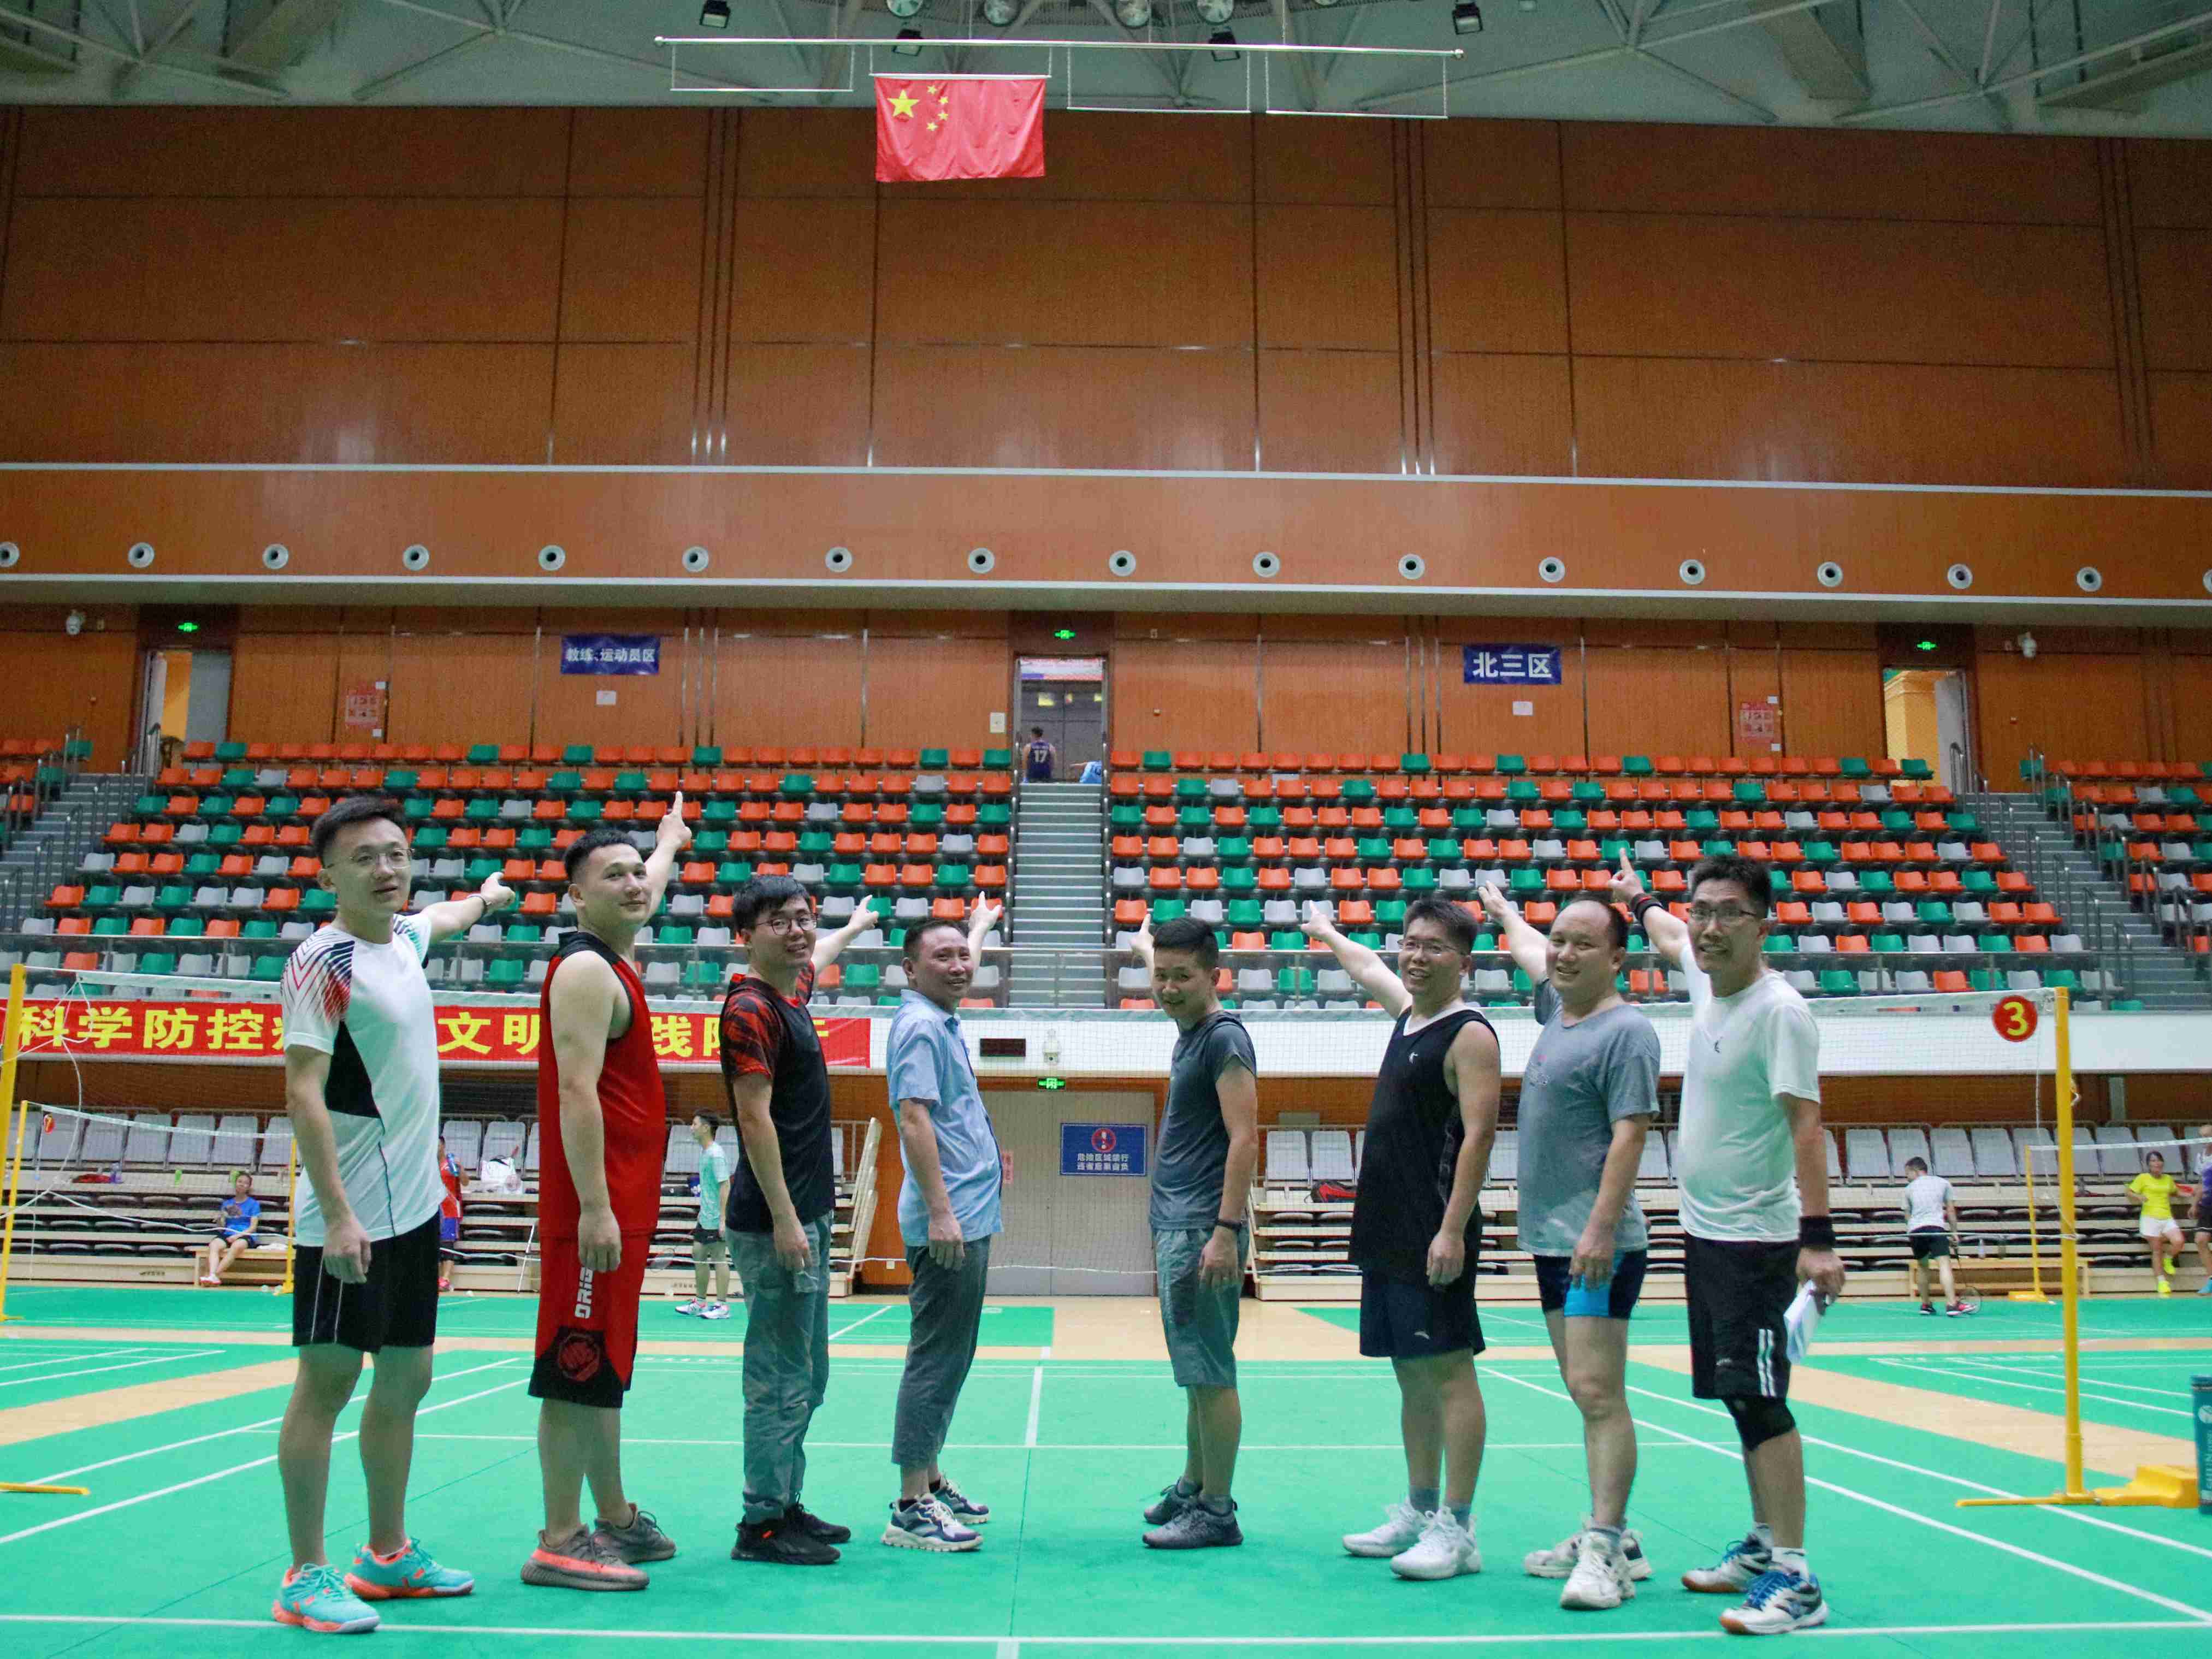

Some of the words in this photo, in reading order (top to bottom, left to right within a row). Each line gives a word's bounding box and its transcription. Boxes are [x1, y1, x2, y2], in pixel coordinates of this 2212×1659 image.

[1472, 651, 1552, 678] 北三区
[1034, 749, 1048, 763] 17
[17, 1006, 283, 1050] 科学防控
[2004, 1001, 2028, 1036] 3
